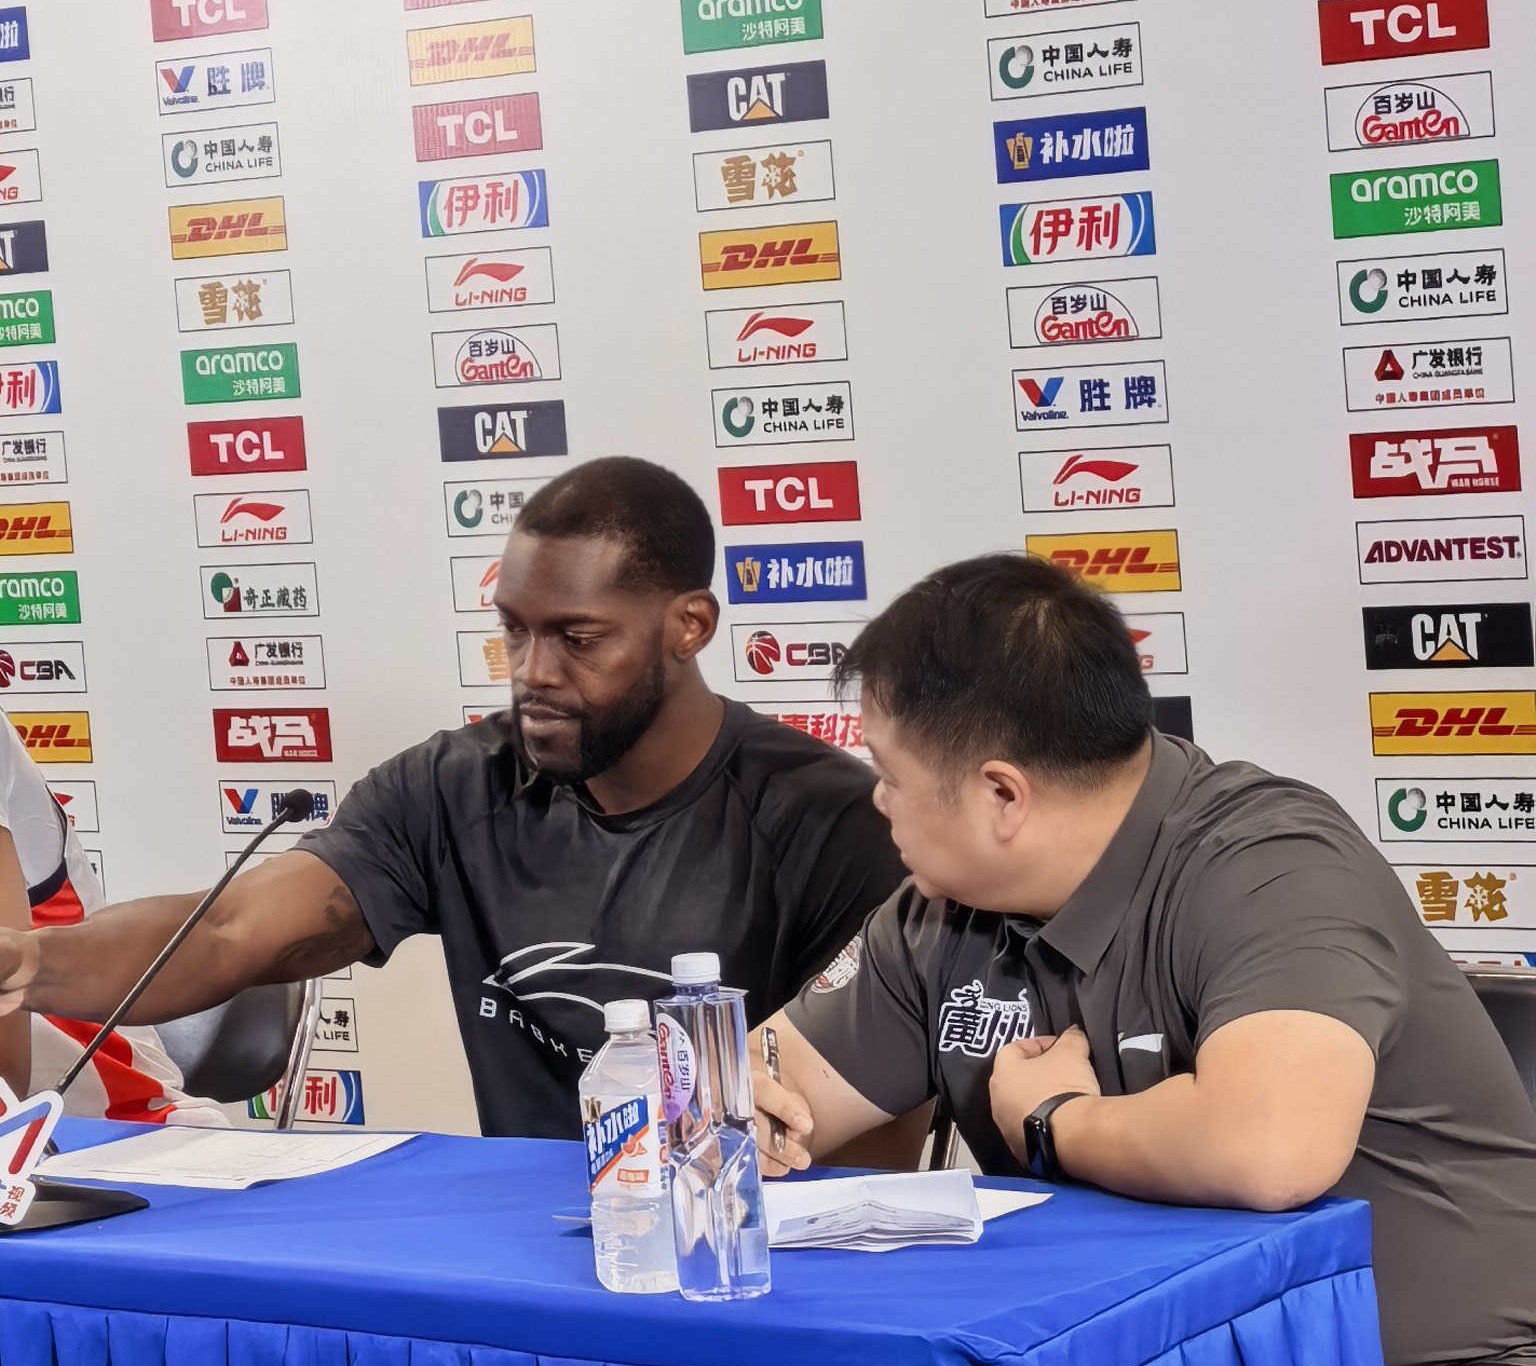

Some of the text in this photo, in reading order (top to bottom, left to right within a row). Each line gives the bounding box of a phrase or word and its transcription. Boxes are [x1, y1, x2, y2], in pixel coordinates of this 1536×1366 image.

[741, 16, 805, 41] 沙特阿美
[1350, 2, 1457, 46] TCL
[426, 32, 514, 67] DHL
[1042, 38, 1133, 67] 中国人寿
[1043, 62, 1133, 83] CHINA LIFE
[727, 72, 785, 122] CAT
[1373, 91, 1436, 115] 百岁山
[437, 110, 518, 146] TCL
[203, 135, 273, 159] 中国人寿
[1040, 124, 1134, 164] 补水啦
[205, 156, 274, 173] CHINA LIFE
[720, 151, 798, 204] 雪花
[1351, 169, 1479, 202] aramco
[444, 180, 519, 229] 伊利
[1404, 201, 1481, 226] 沙特阿美
[186, 212, 268, 242] DHL
[1030, 203, 1121, 256] 伊利
[719, 238, 820, 272] DHL
[1397, 264, 1497, 292] 中国人寿
[198, 278, 264, 325] 雪花
[454, 288, 527, 307] LI-NING
[1051, 293, 1107, 315] 百岁山
[1399, 289, 1496, 308] CHINA LIFE
[469, 338, 516, 357] 百岁山
[737, 343, 817, 363] LI-NING
[1412, 346, 1483, 369] 广发银行
[195, 350, 284, 375] aramco
[232, 376, 286, 396] 沙特阿美
[1079, 376, 1157, 412] 胜牌
[762, 395, 844, 419] 中国人寿
[1021, 410, 1068, 422] Valvoline
[474, 411, 528, 454] CAT
[763, 417, 845, 434] CHINA LIFE
[1, 438, 47, 456] 广发银行
[209, 430, 285, 463] TCL
[1370, 436, 1498, 489] 战马
[744, 477, 834, 511] TCL
[1054, 488, 1142, 506] LI-NING
[221, 526, 287, 543] LI-NING
[1364, 536, 1519, 563] ADVANTEST
[767, 555, 853, 589] 补水啦
[244, 586, 308, 610] 奇正藏药
[18, 603, 67, 621] 沙特阿美
[1411, 613, 1482, 661] CAT
[254, 641, 304, 660] 广发银行
[20, 660, 76, 681] CBA
[1394, 707, 1516, 736] DHL
[227, 715, 317, 758] 战马
[1436, 791, 1535, 814] 中国人寿
[1437, 817, 1536, 830] CHINA LIFE
[1416, 871, 1508, 922] 雪花
[324, 1030, 350, 1041] LIFE
